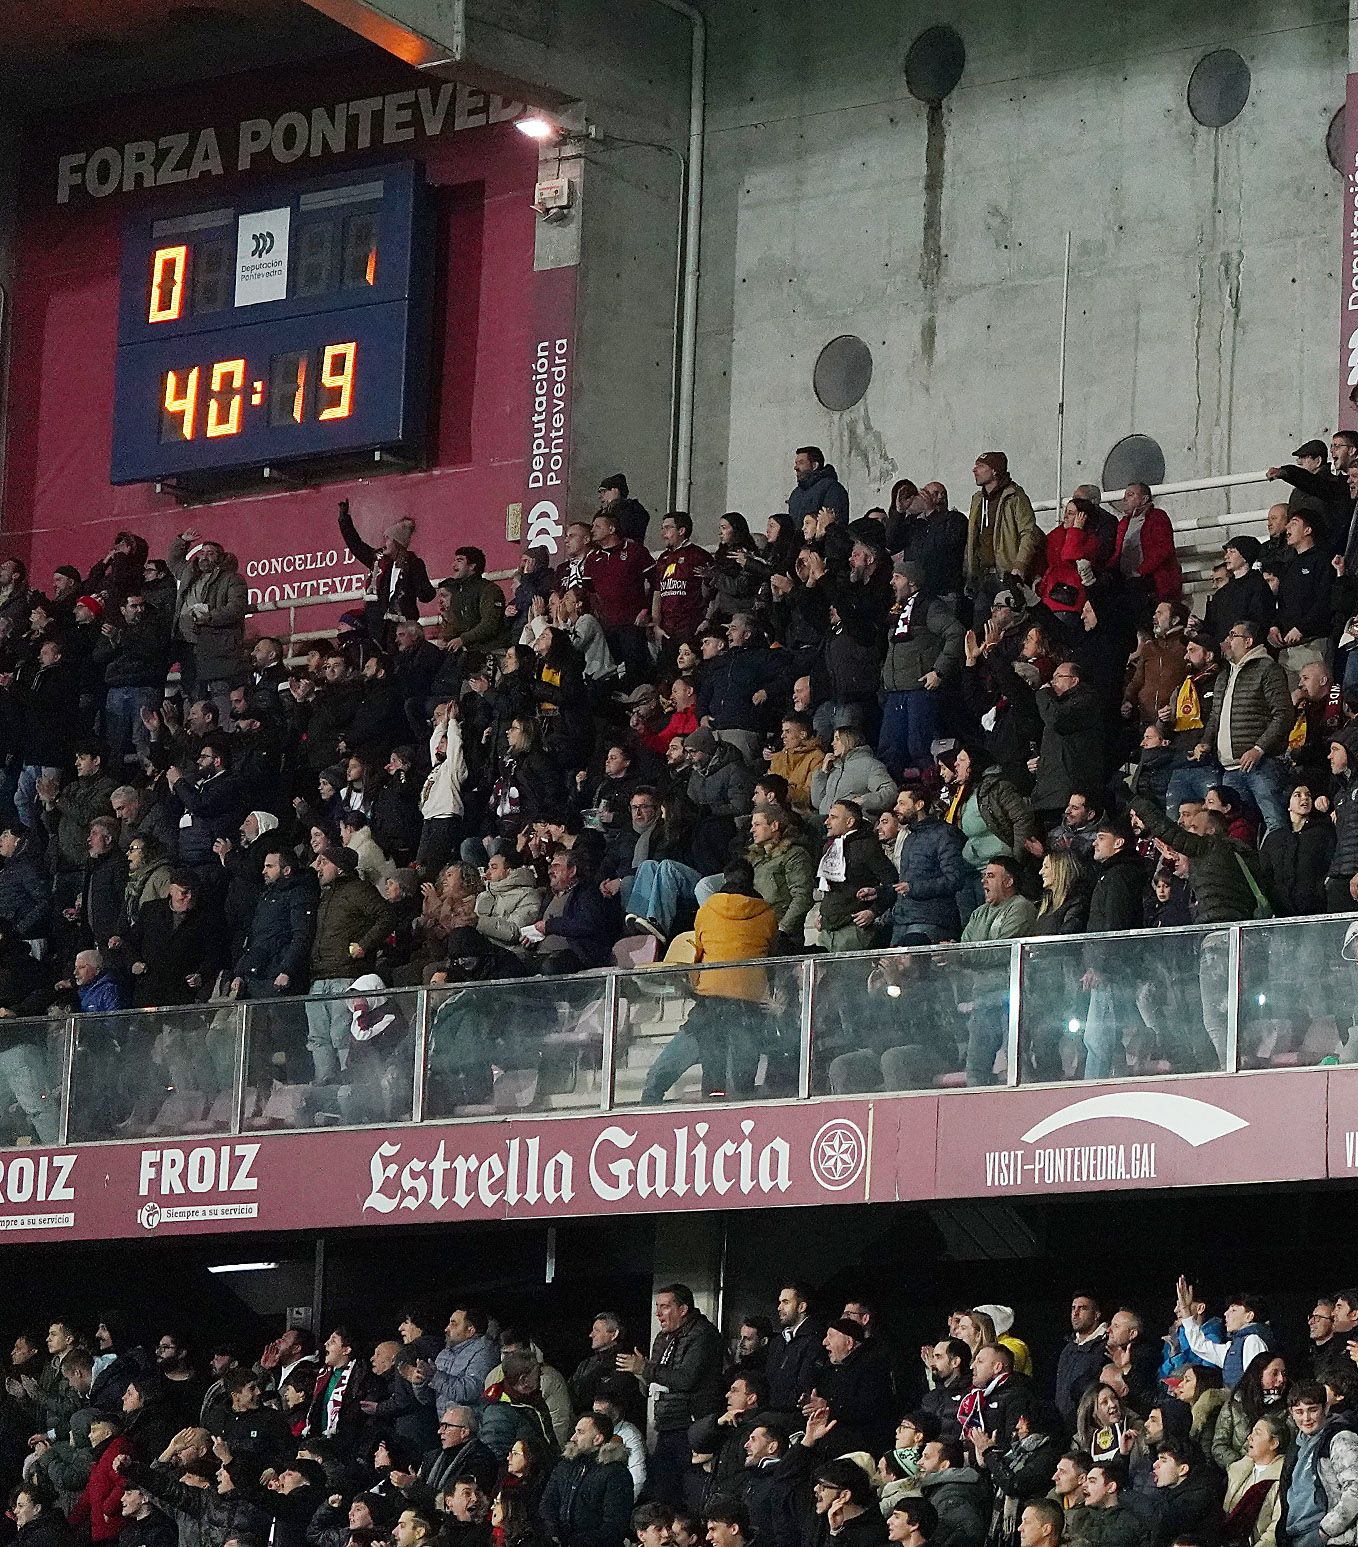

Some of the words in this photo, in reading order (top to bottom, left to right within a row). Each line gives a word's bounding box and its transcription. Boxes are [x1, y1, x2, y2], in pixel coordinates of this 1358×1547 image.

[56, 127, 224, 204] FORZA
[148, 245, 188, 323] 0
[240, 257, 283, 273] Deputación
[240, 268, 283, 283] Pontevedra
[164, 340, 359, 442] 40:19
[528, 340, 550, 489] Deputación
[546, 338, 568, 486] Pontevedra
[246, 550, 338, 577] CONCELLO
[0, 1154, 78, 1203] OIZ
[139, 1143, 261, 1196] FROIZ
[362, 1135, 576, 1213] Estrella
[588, 1119, 793, 1201] Galicia
[985, 1142, 1157, 1187] VISIT-PONTEVEDRA.GAL
[27, 1217, 36, 1226] su
[38, 1214, 70, 1225] servicio
[166, 1208, 200, 1220] Siempre
[201, 1209, 207, 1217] a
[208, 1208, 218, 1217] su
[220, 1204, 253, 1216] servicio
